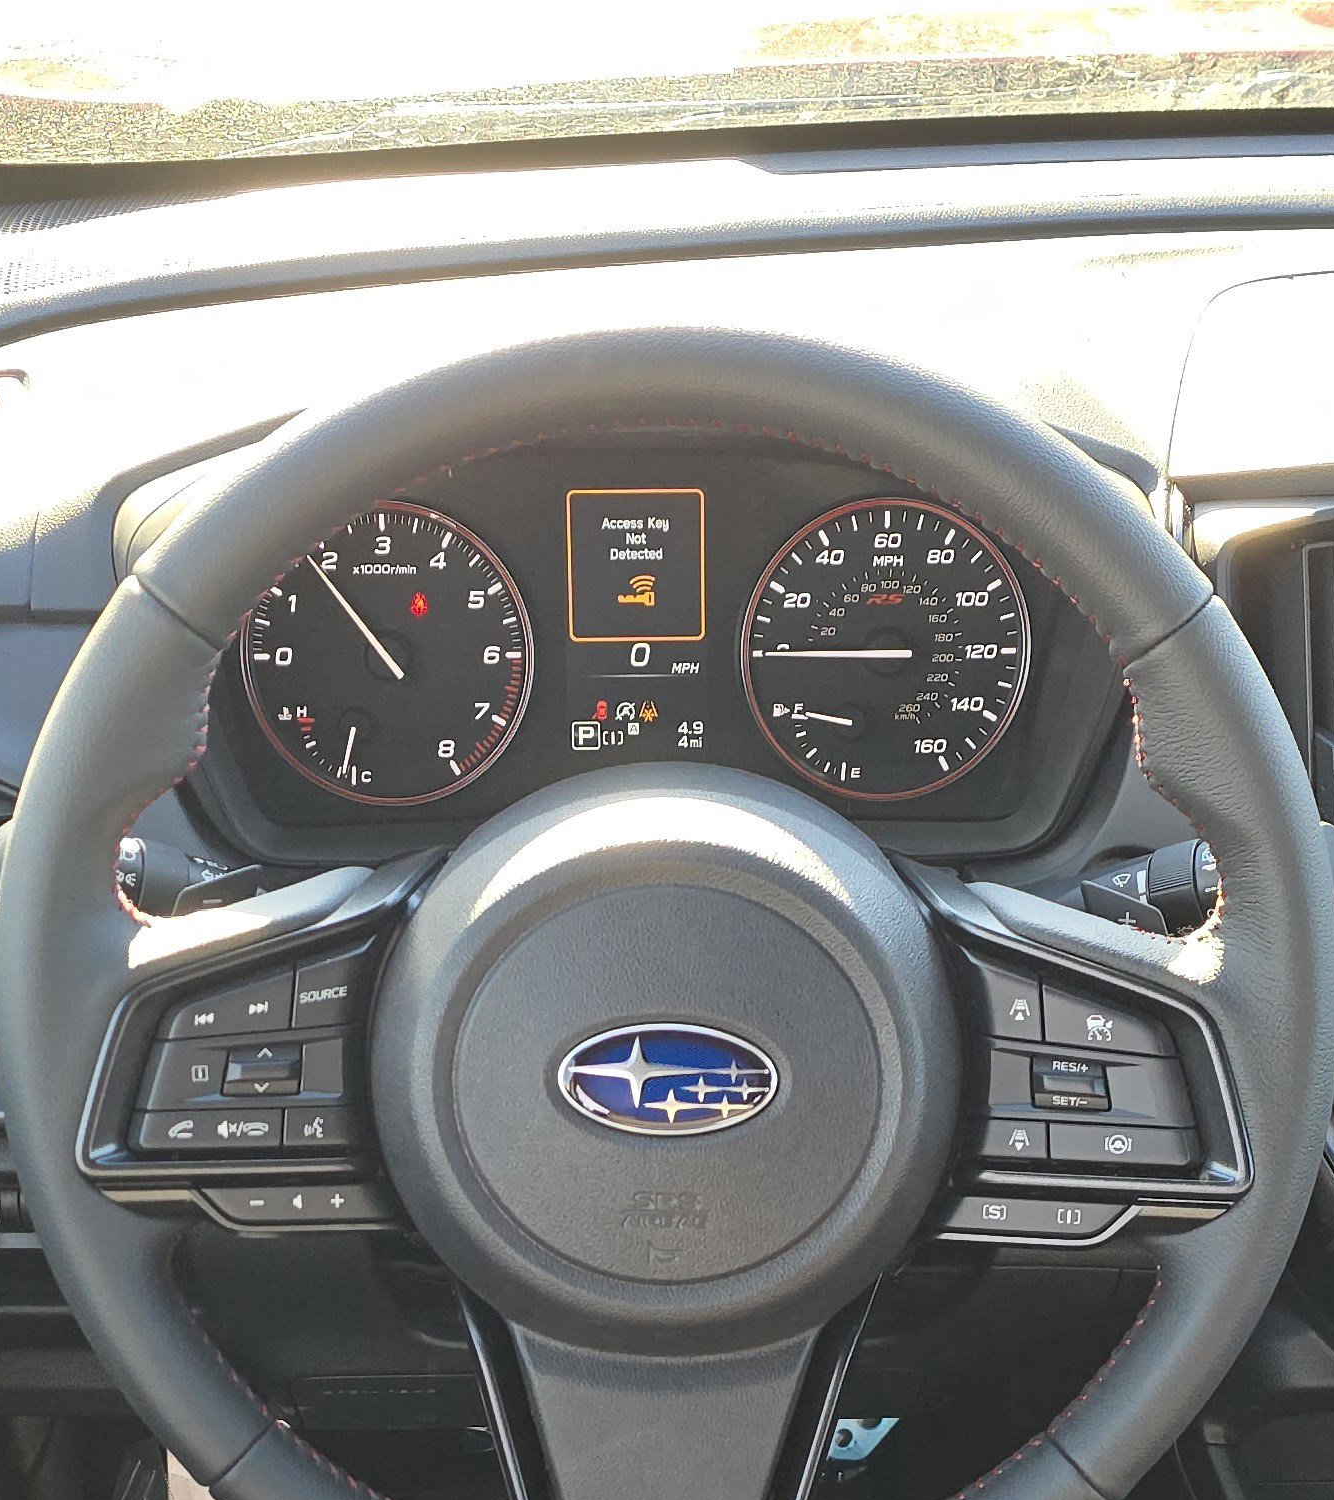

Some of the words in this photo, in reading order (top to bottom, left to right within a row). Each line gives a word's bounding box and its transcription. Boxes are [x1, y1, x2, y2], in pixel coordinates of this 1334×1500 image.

[601, 517, 643, 530] Access
[647, 516, 670, 532] Key
[374, 536, 391, 555] 3
[625, 532, 647, 545] Not
[873, 532, 902, 549] 60
[321, 551, 339, 571] 2
[429, 551, 447, 570] 4
[609, 547, 664, 561] Detected
[815, 549, 845, 565] 40
[872, 554, 904, 567] MPH
[926, 548, 955, 564] 80
[860, 582, 877, 594] 80
[880, 579, 900, 590] 100
[902, 583, 922, 595] 120
[288, 594, 298, 613] 1
[467, 590, 485, 609] 5
[783, 592, 811, 609] 20
[843, 593, 860, 603] 60
[918, 596, 939, 606] 140
[955, 591, 989, 607] 100
[828, 607, 846, 617] 40
[928, 613, 948, 623] 160
[820, 626, 836, 636] 20
[934, 632, 954, 642] 180
[275, 647, 293, 666] 0
[483, 646, 501, 664] 6
[630, 642, 651, 667] 0
[931, 653, 954, 663] 200
[965, 643, 998, 659] 120
[671, 662, 700, 674] MPH
[926, 673, 948, 682] 220
[916, 692, 939, 701] 240
[950, 696, 984, 712] 140
[296, 706, 308, 718] H
[474, 702, 491, 720] 7
[898, 703, 921, 713] 260
[677, 720, 704, 735] 4.9
[578, 726, 595, 745] P
[437, 739, 456, 758] 8
[913, 738, 947, 753] 160
[361, 770, 372, 783] C
[850, 767, 861, 779] E
[299, 985, 349, 1005] SOURCE
[1052, 1060, 1089, 1074] RES/+
